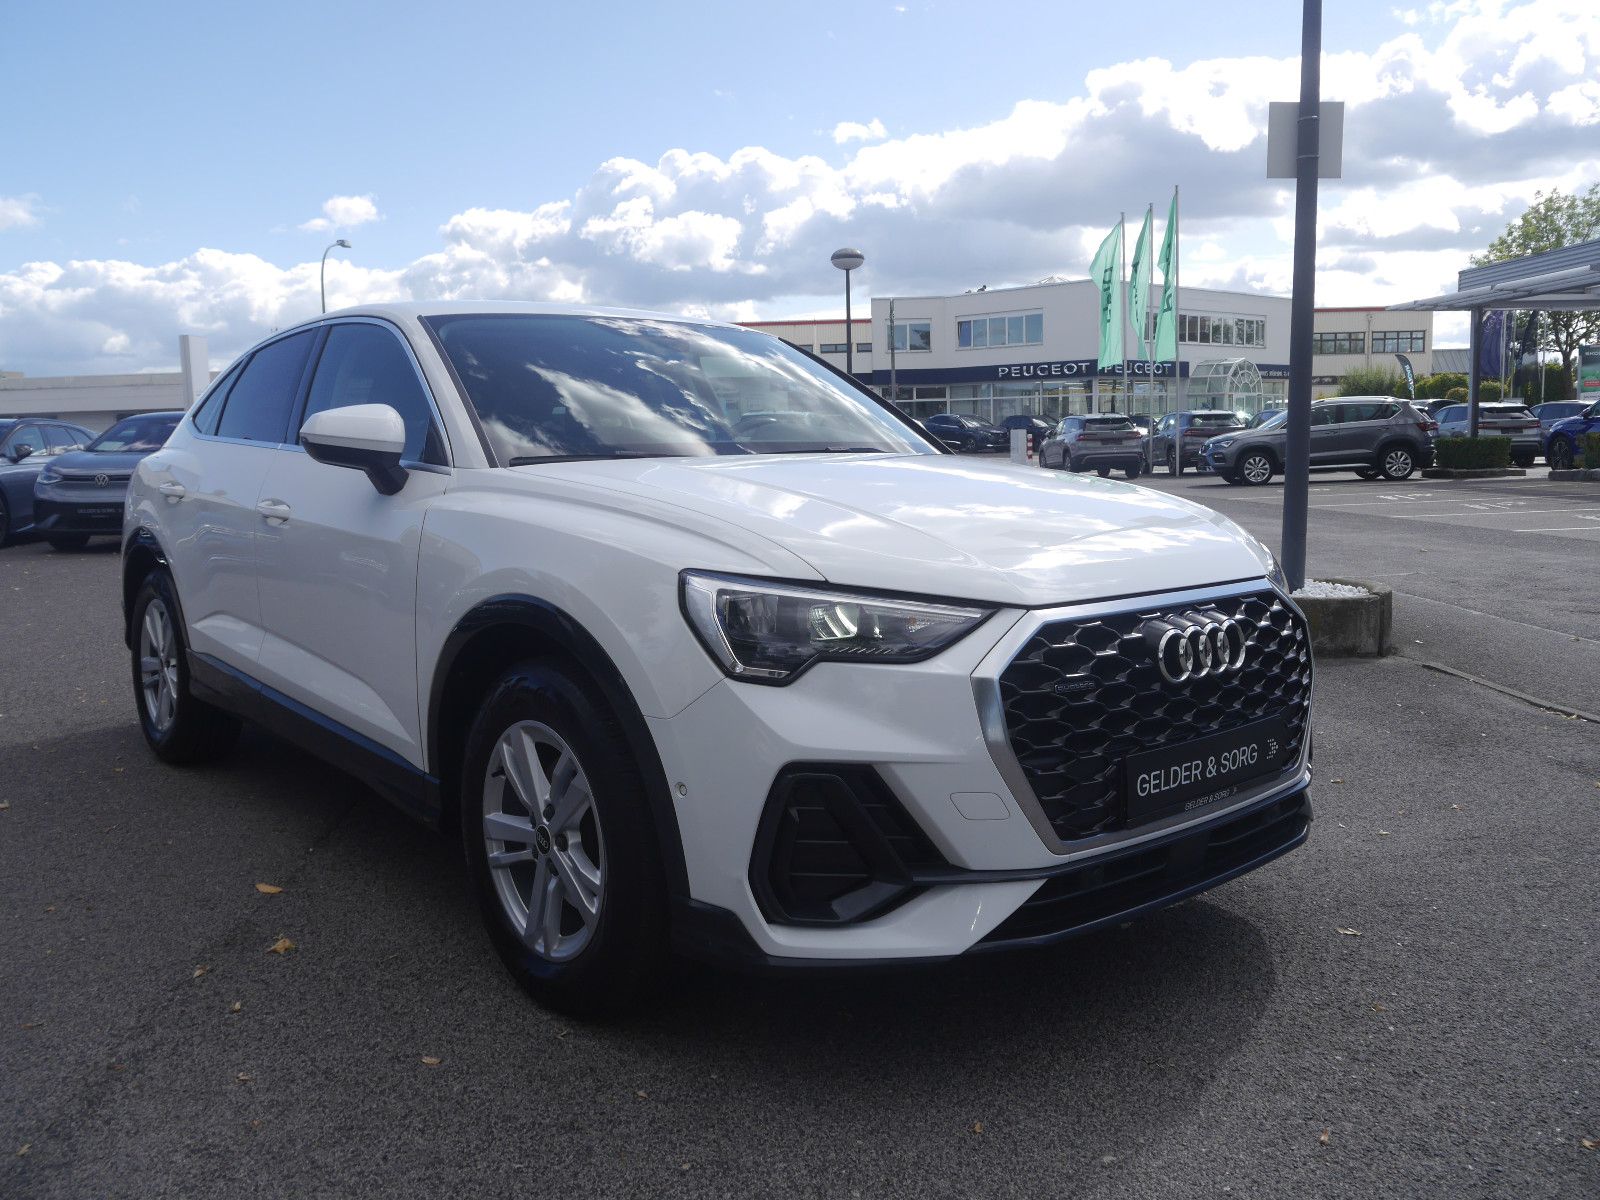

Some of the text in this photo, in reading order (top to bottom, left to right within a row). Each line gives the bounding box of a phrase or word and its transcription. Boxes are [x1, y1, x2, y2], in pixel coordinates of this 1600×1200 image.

[998, 363, 1090, 378] PEUGEOT
[1137, 743, 1258, 797] GELDER & SORG
[1185, 790, 1230, 811] GELDER & SORG
